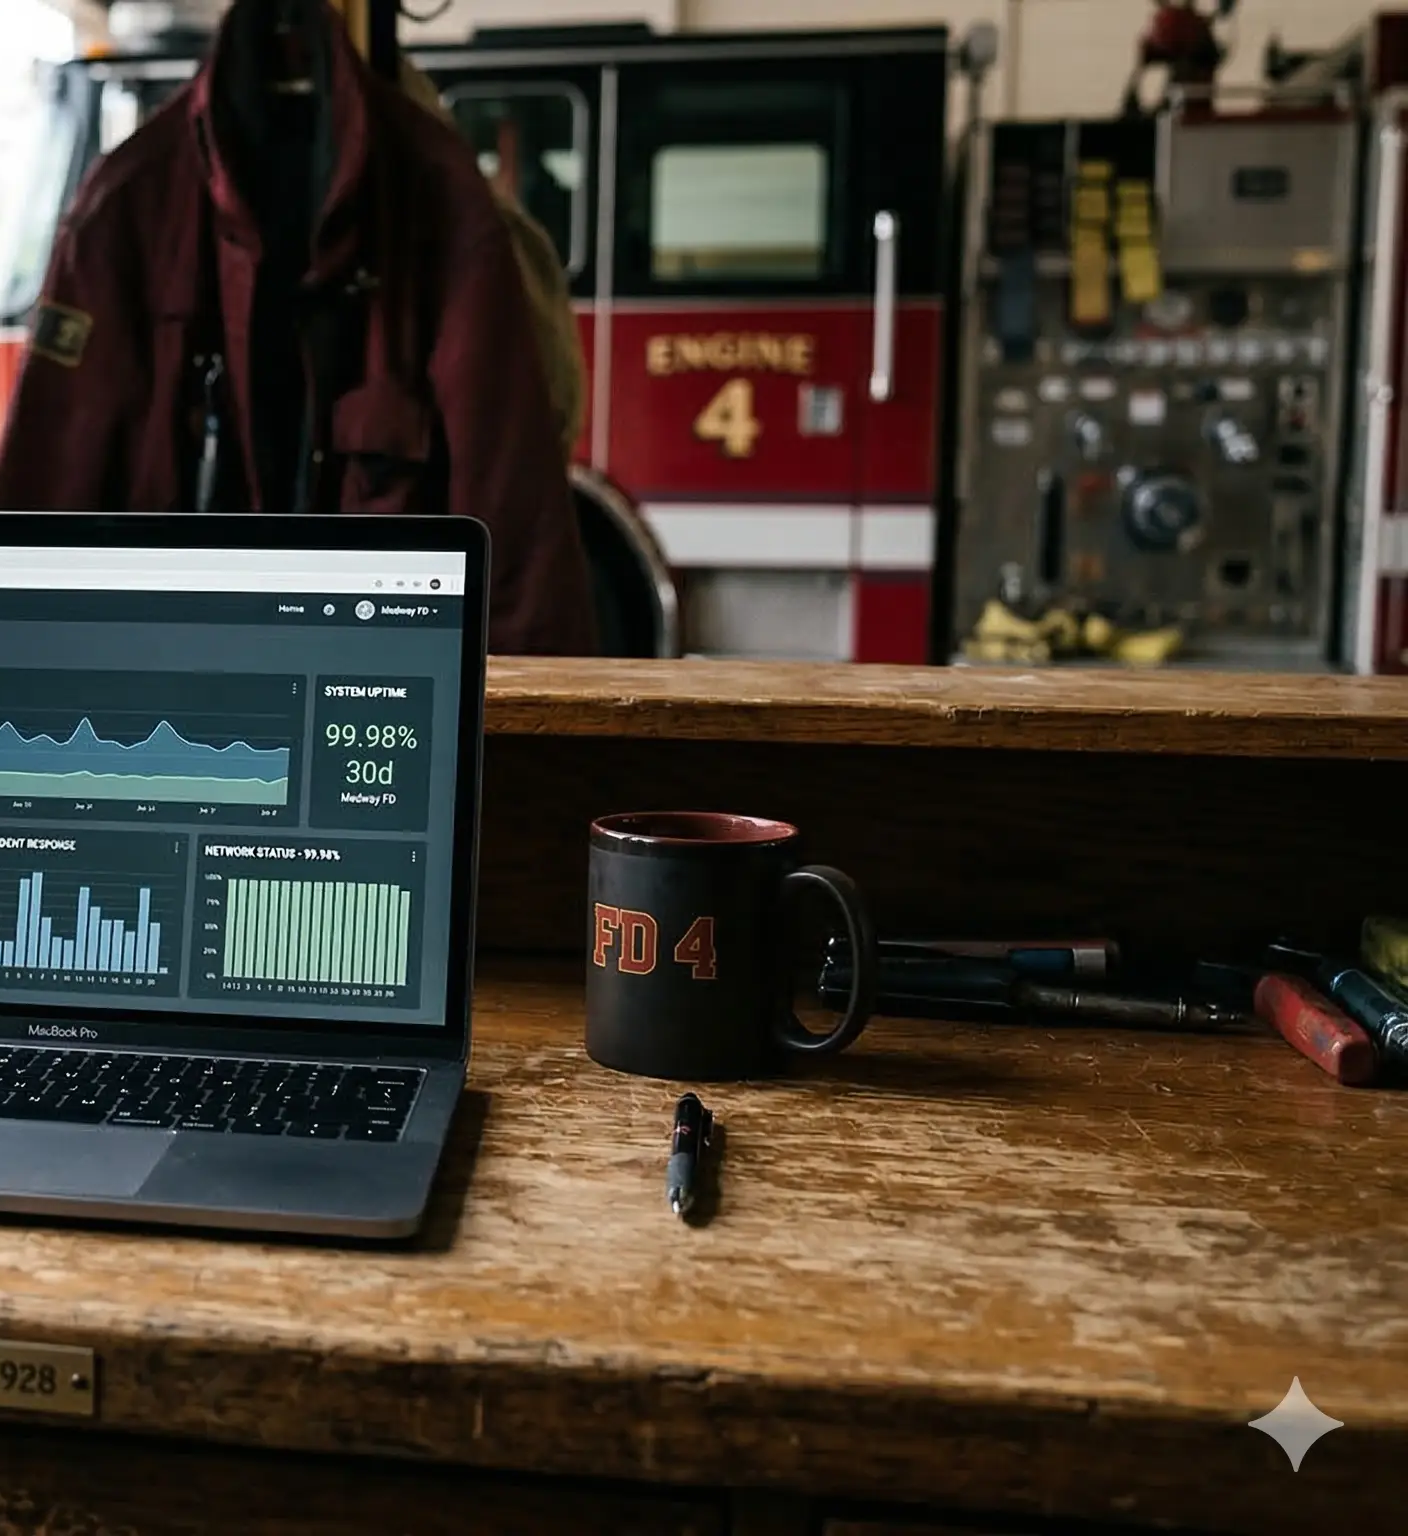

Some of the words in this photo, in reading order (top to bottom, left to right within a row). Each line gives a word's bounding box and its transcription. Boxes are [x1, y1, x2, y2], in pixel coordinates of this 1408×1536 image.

[646, 332, 813, 376] ENGINE
[695, 378, 760, 458] 4
[324, 685, 366, 697] SYSTEM
[367, 686, 408, 698] UPTIME
[325, 723, 418, 749] 99.98%
[345, 760, 393, 785] 30d
[382, 793, 397, 805] FD
[204, 845, 255, 858] NETWORK
[256, 846, 296, 859] STATUS
[593, 902, 658, 975] FD
[674, 916, 718, 980] 4
[28, 1024, 78, 1038] MacBook
[79, 1026, 99, 1039] Pro
